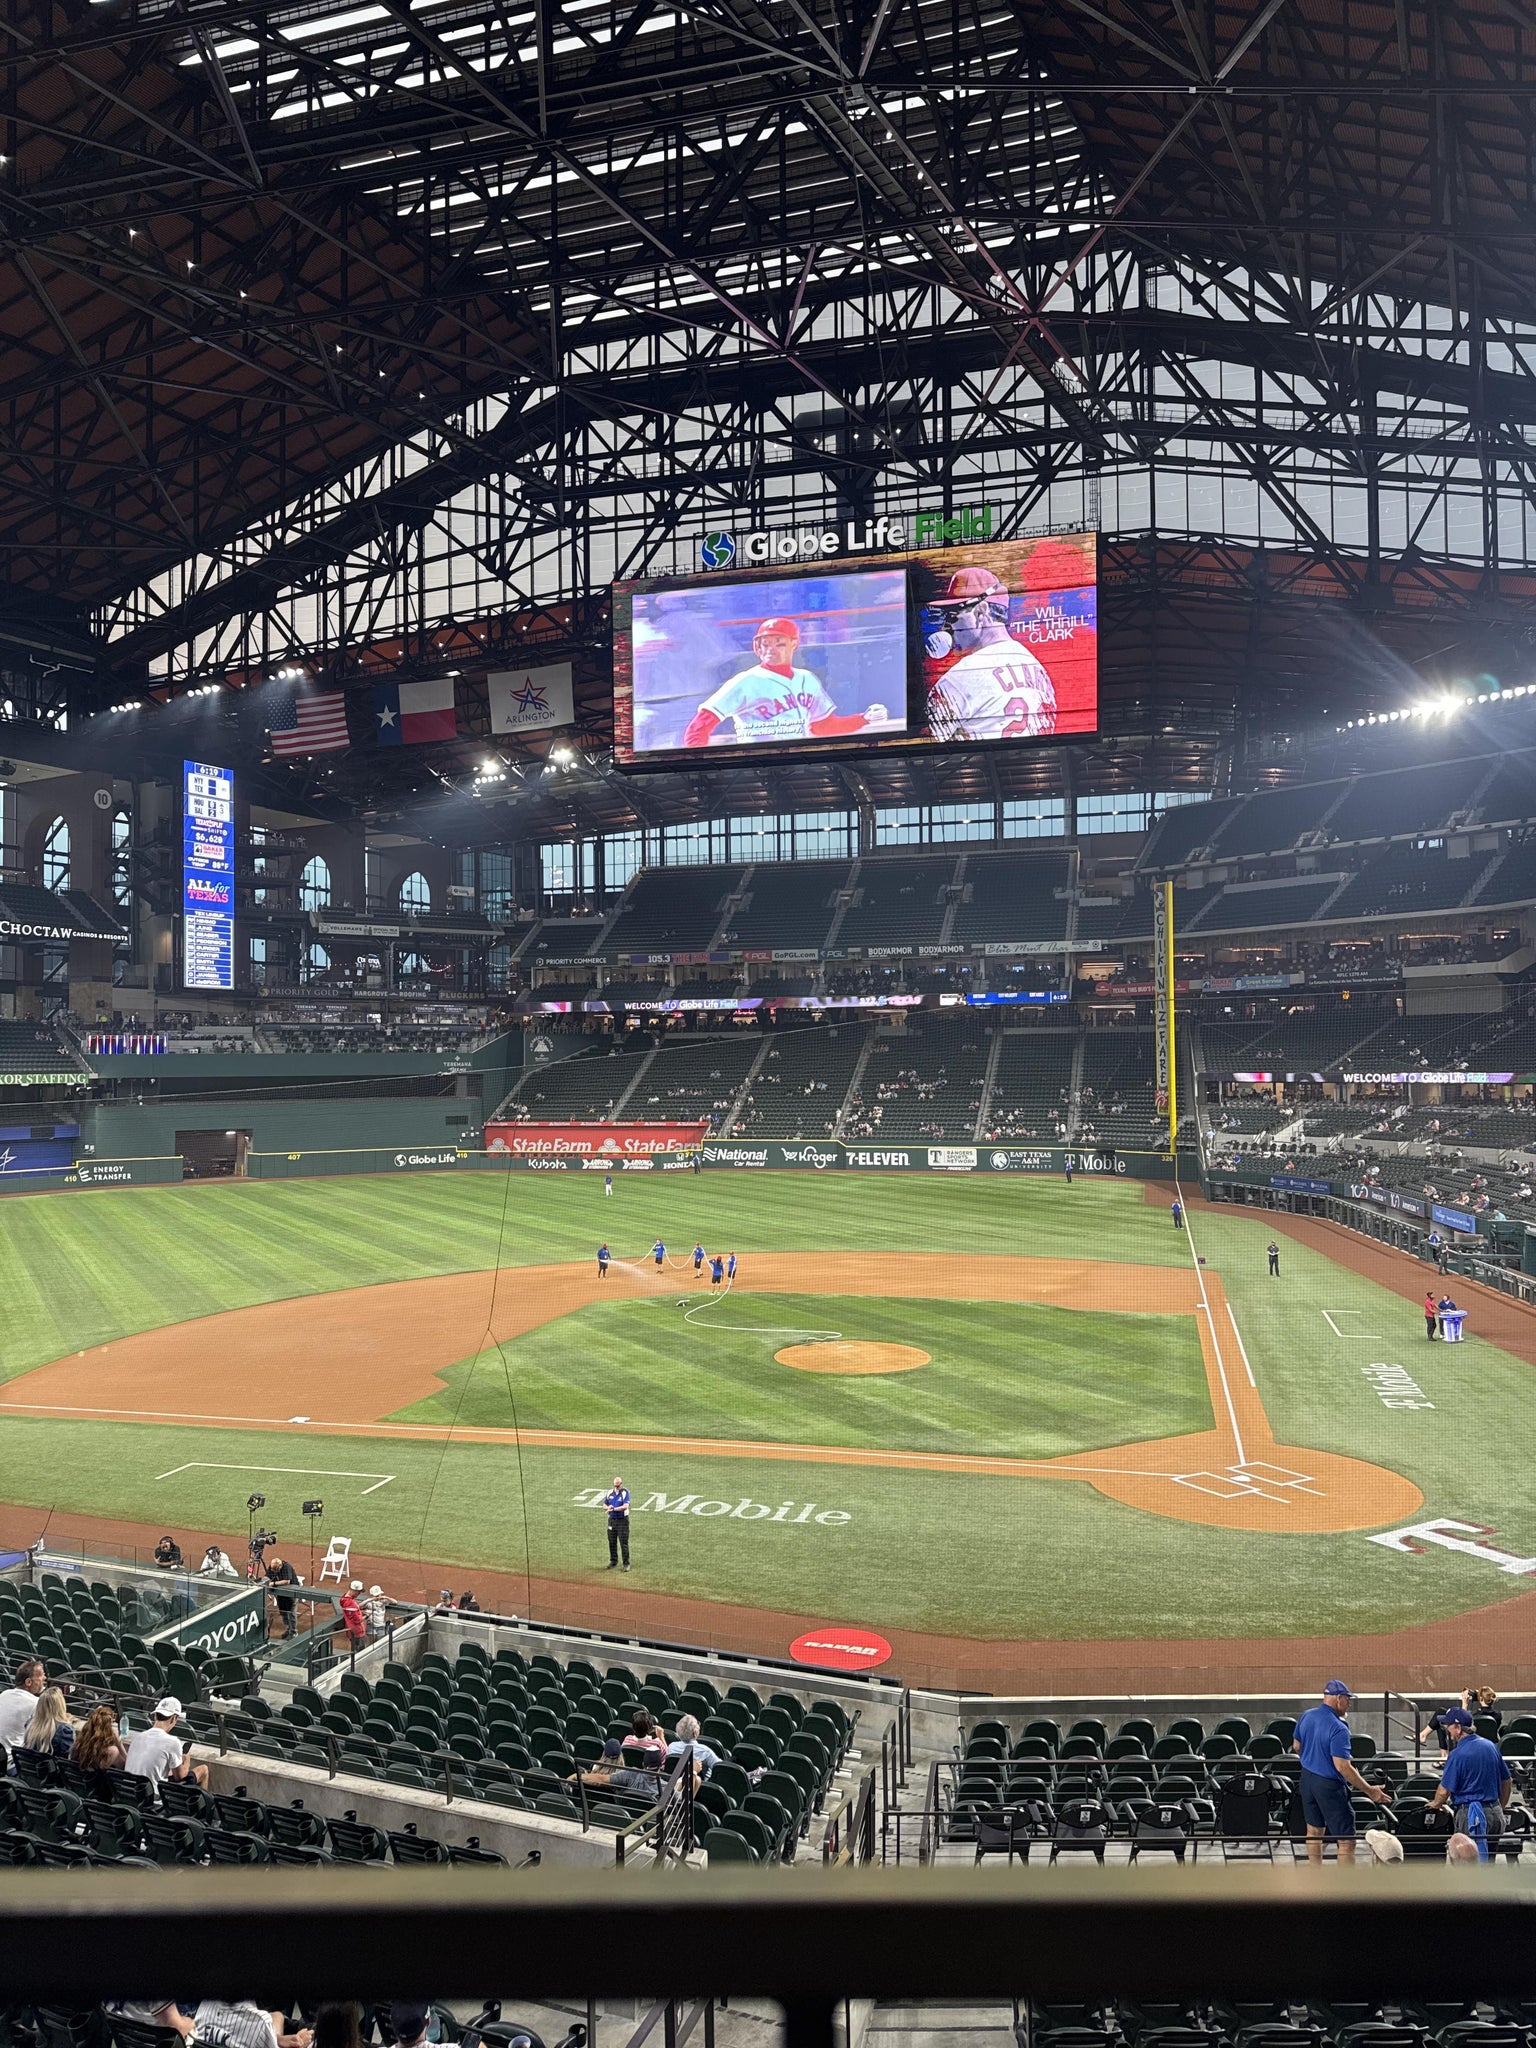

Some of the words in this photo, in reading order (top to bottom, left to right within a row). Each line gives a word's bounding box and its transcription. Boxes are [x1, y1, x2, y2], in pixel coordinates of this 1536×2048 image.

[745, 529, 839, 560] Globe
[848, 517, 905, 550] Life
[916, 505, 992, 542] Field
[1036, 606, 1066, 618] WILL
[1029, 628, 1074, 644] CLARK
[506, 710, 555, 724] ARLINGTON
[200, 766, 218, 776] 6:19
[98, 793, 108, 805] 10
[187, 879, 214, 892] ALL
[214, 882, 230, 897] for
[188, 890, 229, 903] TEXAS
[0, 921, 72, 938] CHOCTAW
[868, 947, 912, 955] BODYARMOR
[918, 946, 964, 954] BODYARMOR
[648, 955, 670, 963] 105.3
[679, 1000, 702, 1008] Globe
[26, 1074, 86, 1084] STAFFING
[1344, 1073, 1397, 1083] WELCOME
[1402, 1073, 1417, 1082] TO
[1421, 1072, 1448, 1083] Globe
[1450, 1072, 1466, 1083] Life
[1467, 1073, 1486, 1082] Field
[408, 1155, 436, 1164] Globe
[438, 1154, 456, 1163] Life
[799, 1146, 838, 1169] Kroger
[528, 1159, 567, 1169] Kubota
[631, 1492, 852, 1526] Mobile
